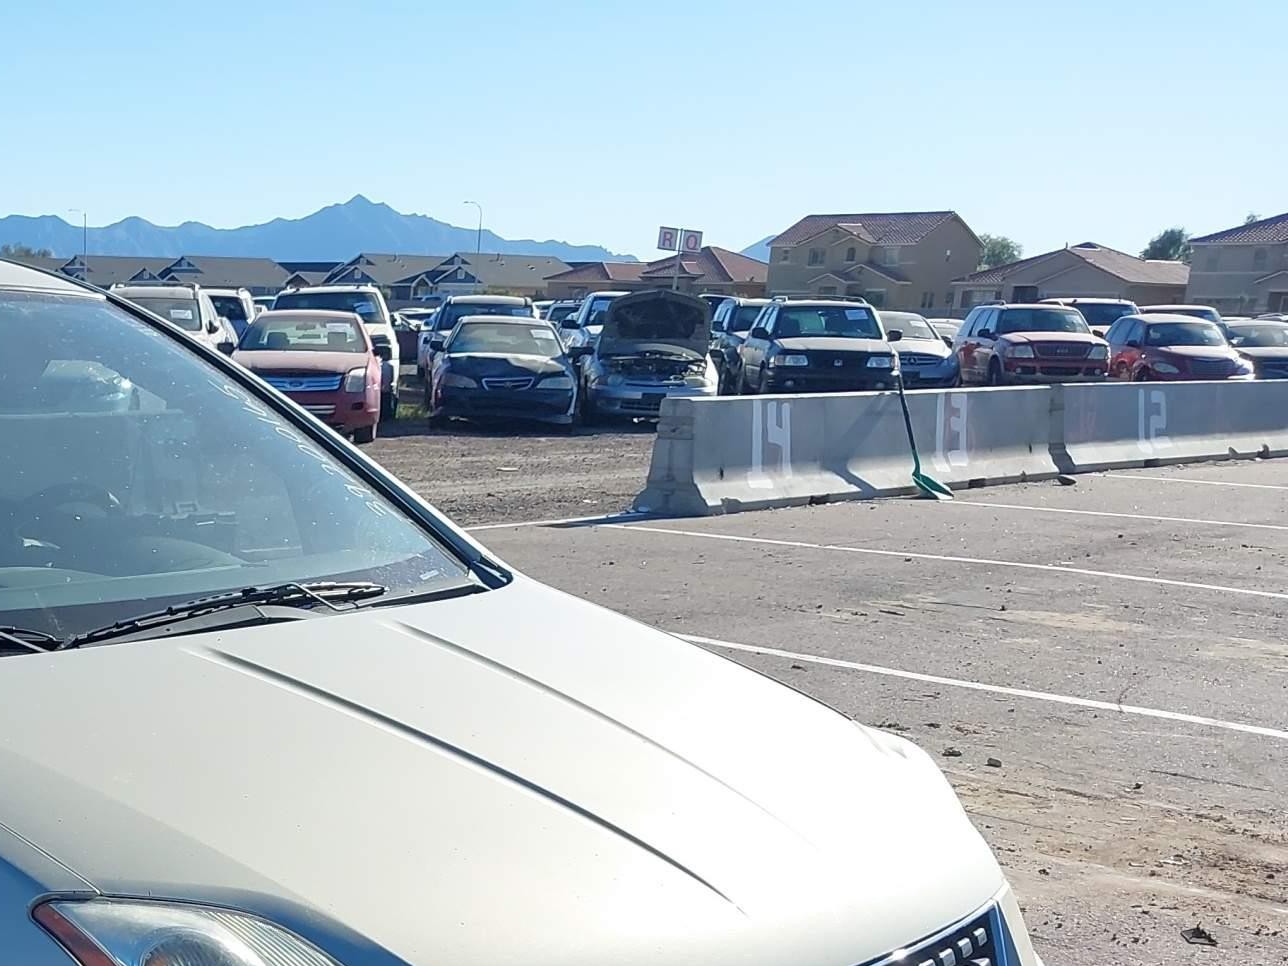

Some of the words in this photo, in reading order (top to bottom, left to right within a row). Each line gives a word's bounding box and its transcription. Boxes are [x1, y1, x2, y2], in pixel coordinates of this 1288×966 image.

[662, 231, 673, 247] R
[747, 399, 792, 488] 14
[931, 393, 968, 473] 13
[1137, 389, 1172, 454] 12
